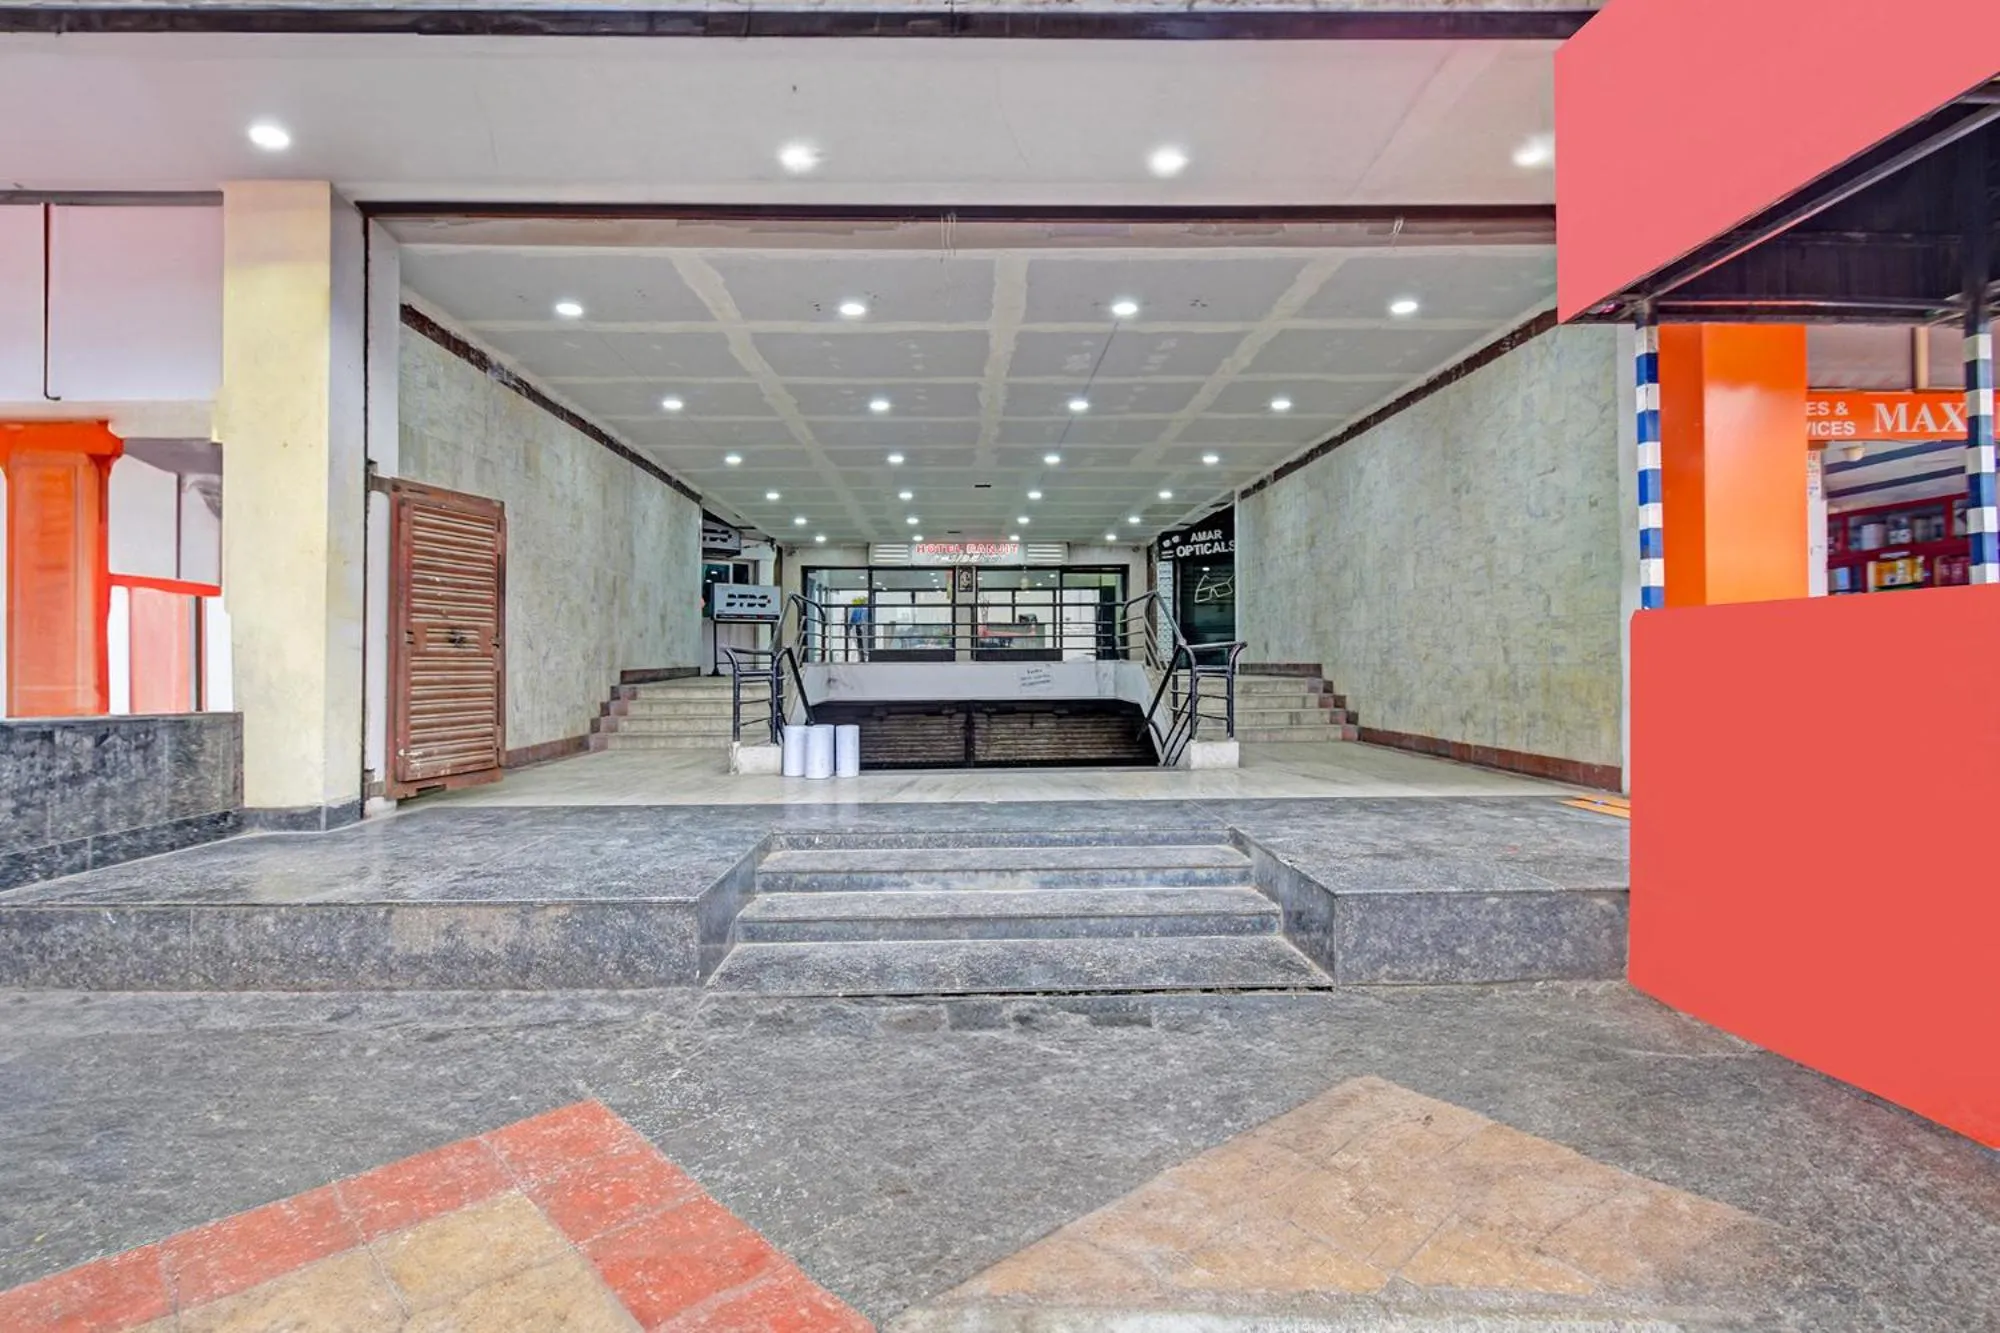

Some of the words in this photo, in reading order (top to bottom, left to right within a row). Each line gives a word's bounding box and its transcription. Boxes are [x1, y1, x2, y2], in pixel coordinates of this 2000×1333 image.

[1835, 401, 1848, 416] &
[1872, 402, 1968, 433] MAX
[1190, 529, 1222, 543] AMAR
[916, 543, 962, 554] HOTEL
[966, 543, 1019, 555] RANJIT
[1176, 540, 1235, 557] OPTICALS
